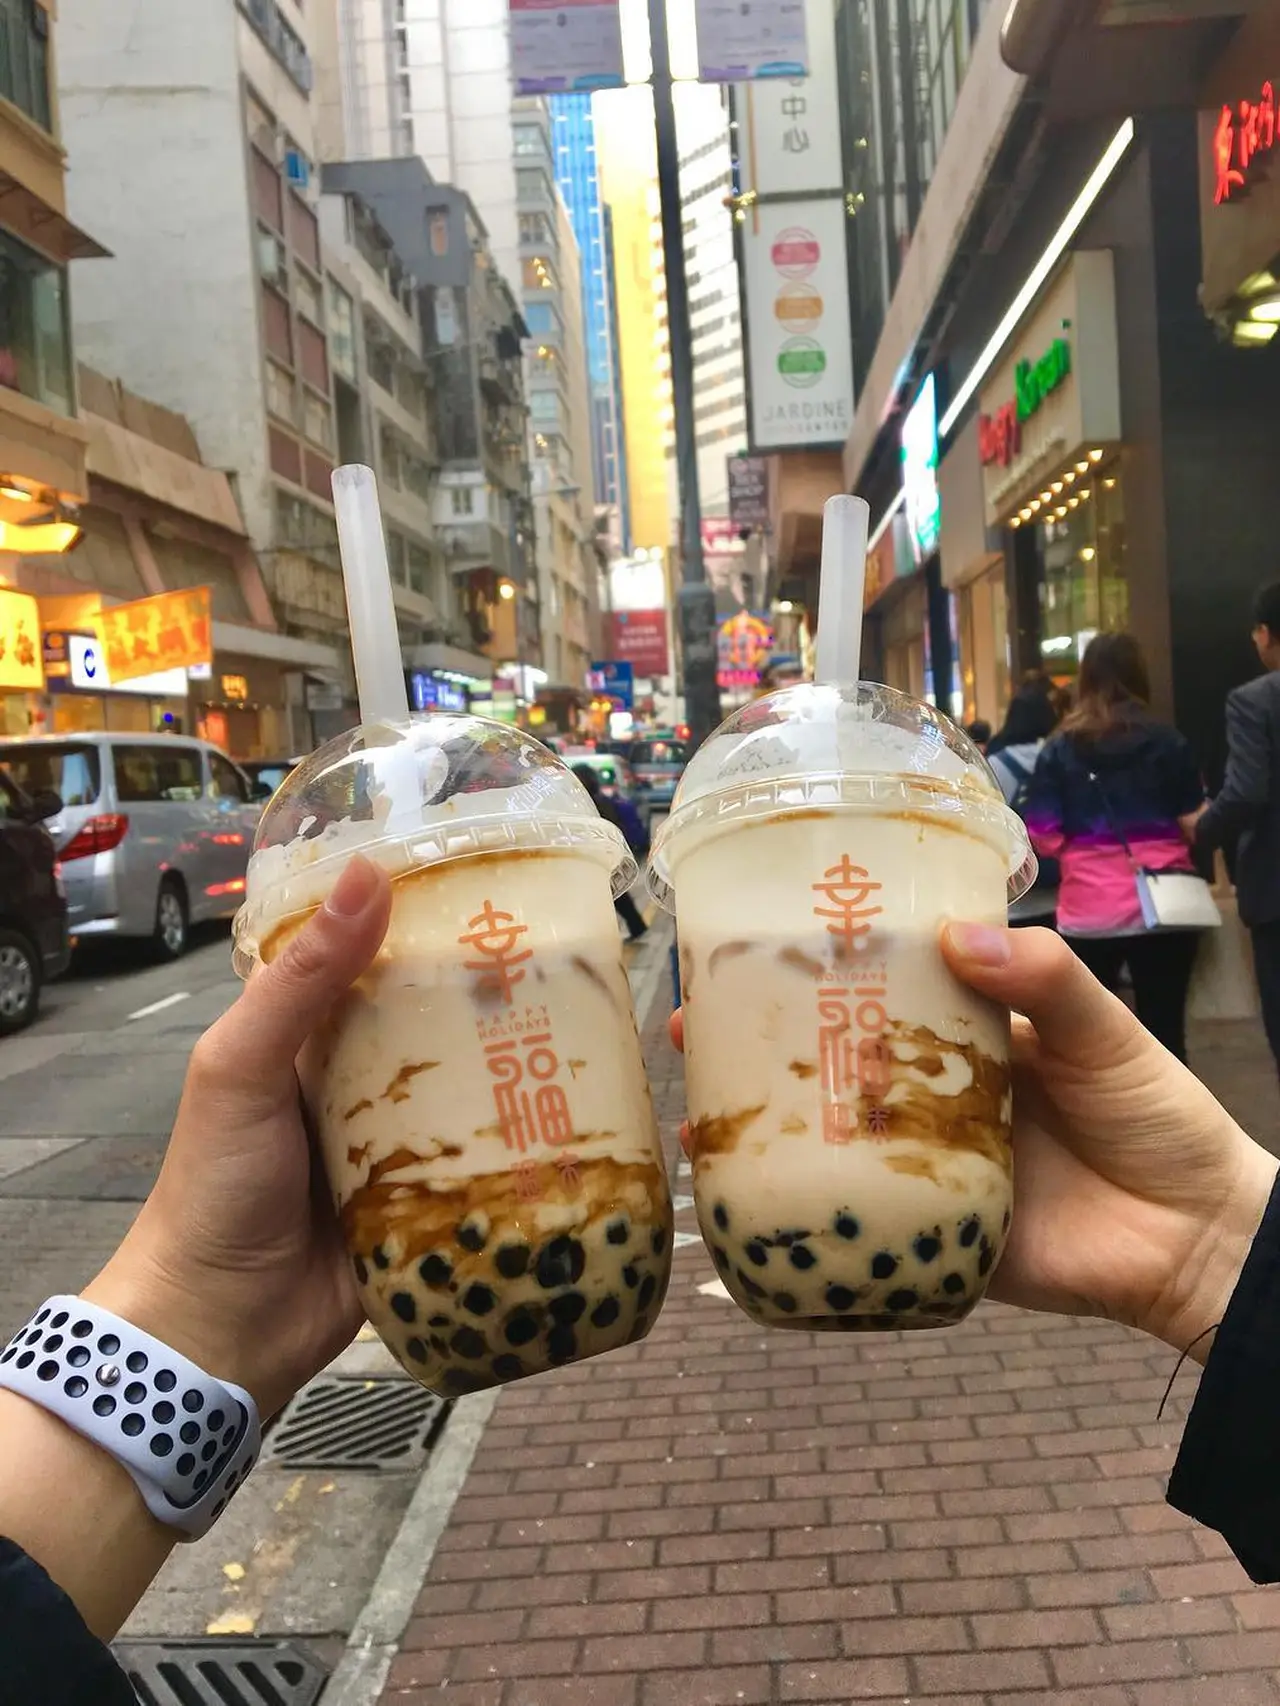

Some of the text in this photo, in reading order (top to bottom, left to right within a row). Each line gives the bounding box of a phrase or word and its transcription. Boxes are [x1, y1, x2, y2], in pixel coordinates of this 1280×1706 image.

[781, 80, 809, 153] 中心
[762, 398, 848, 421] JARDINE
[477, 1016, 551, 1041] HOLIDAYS
